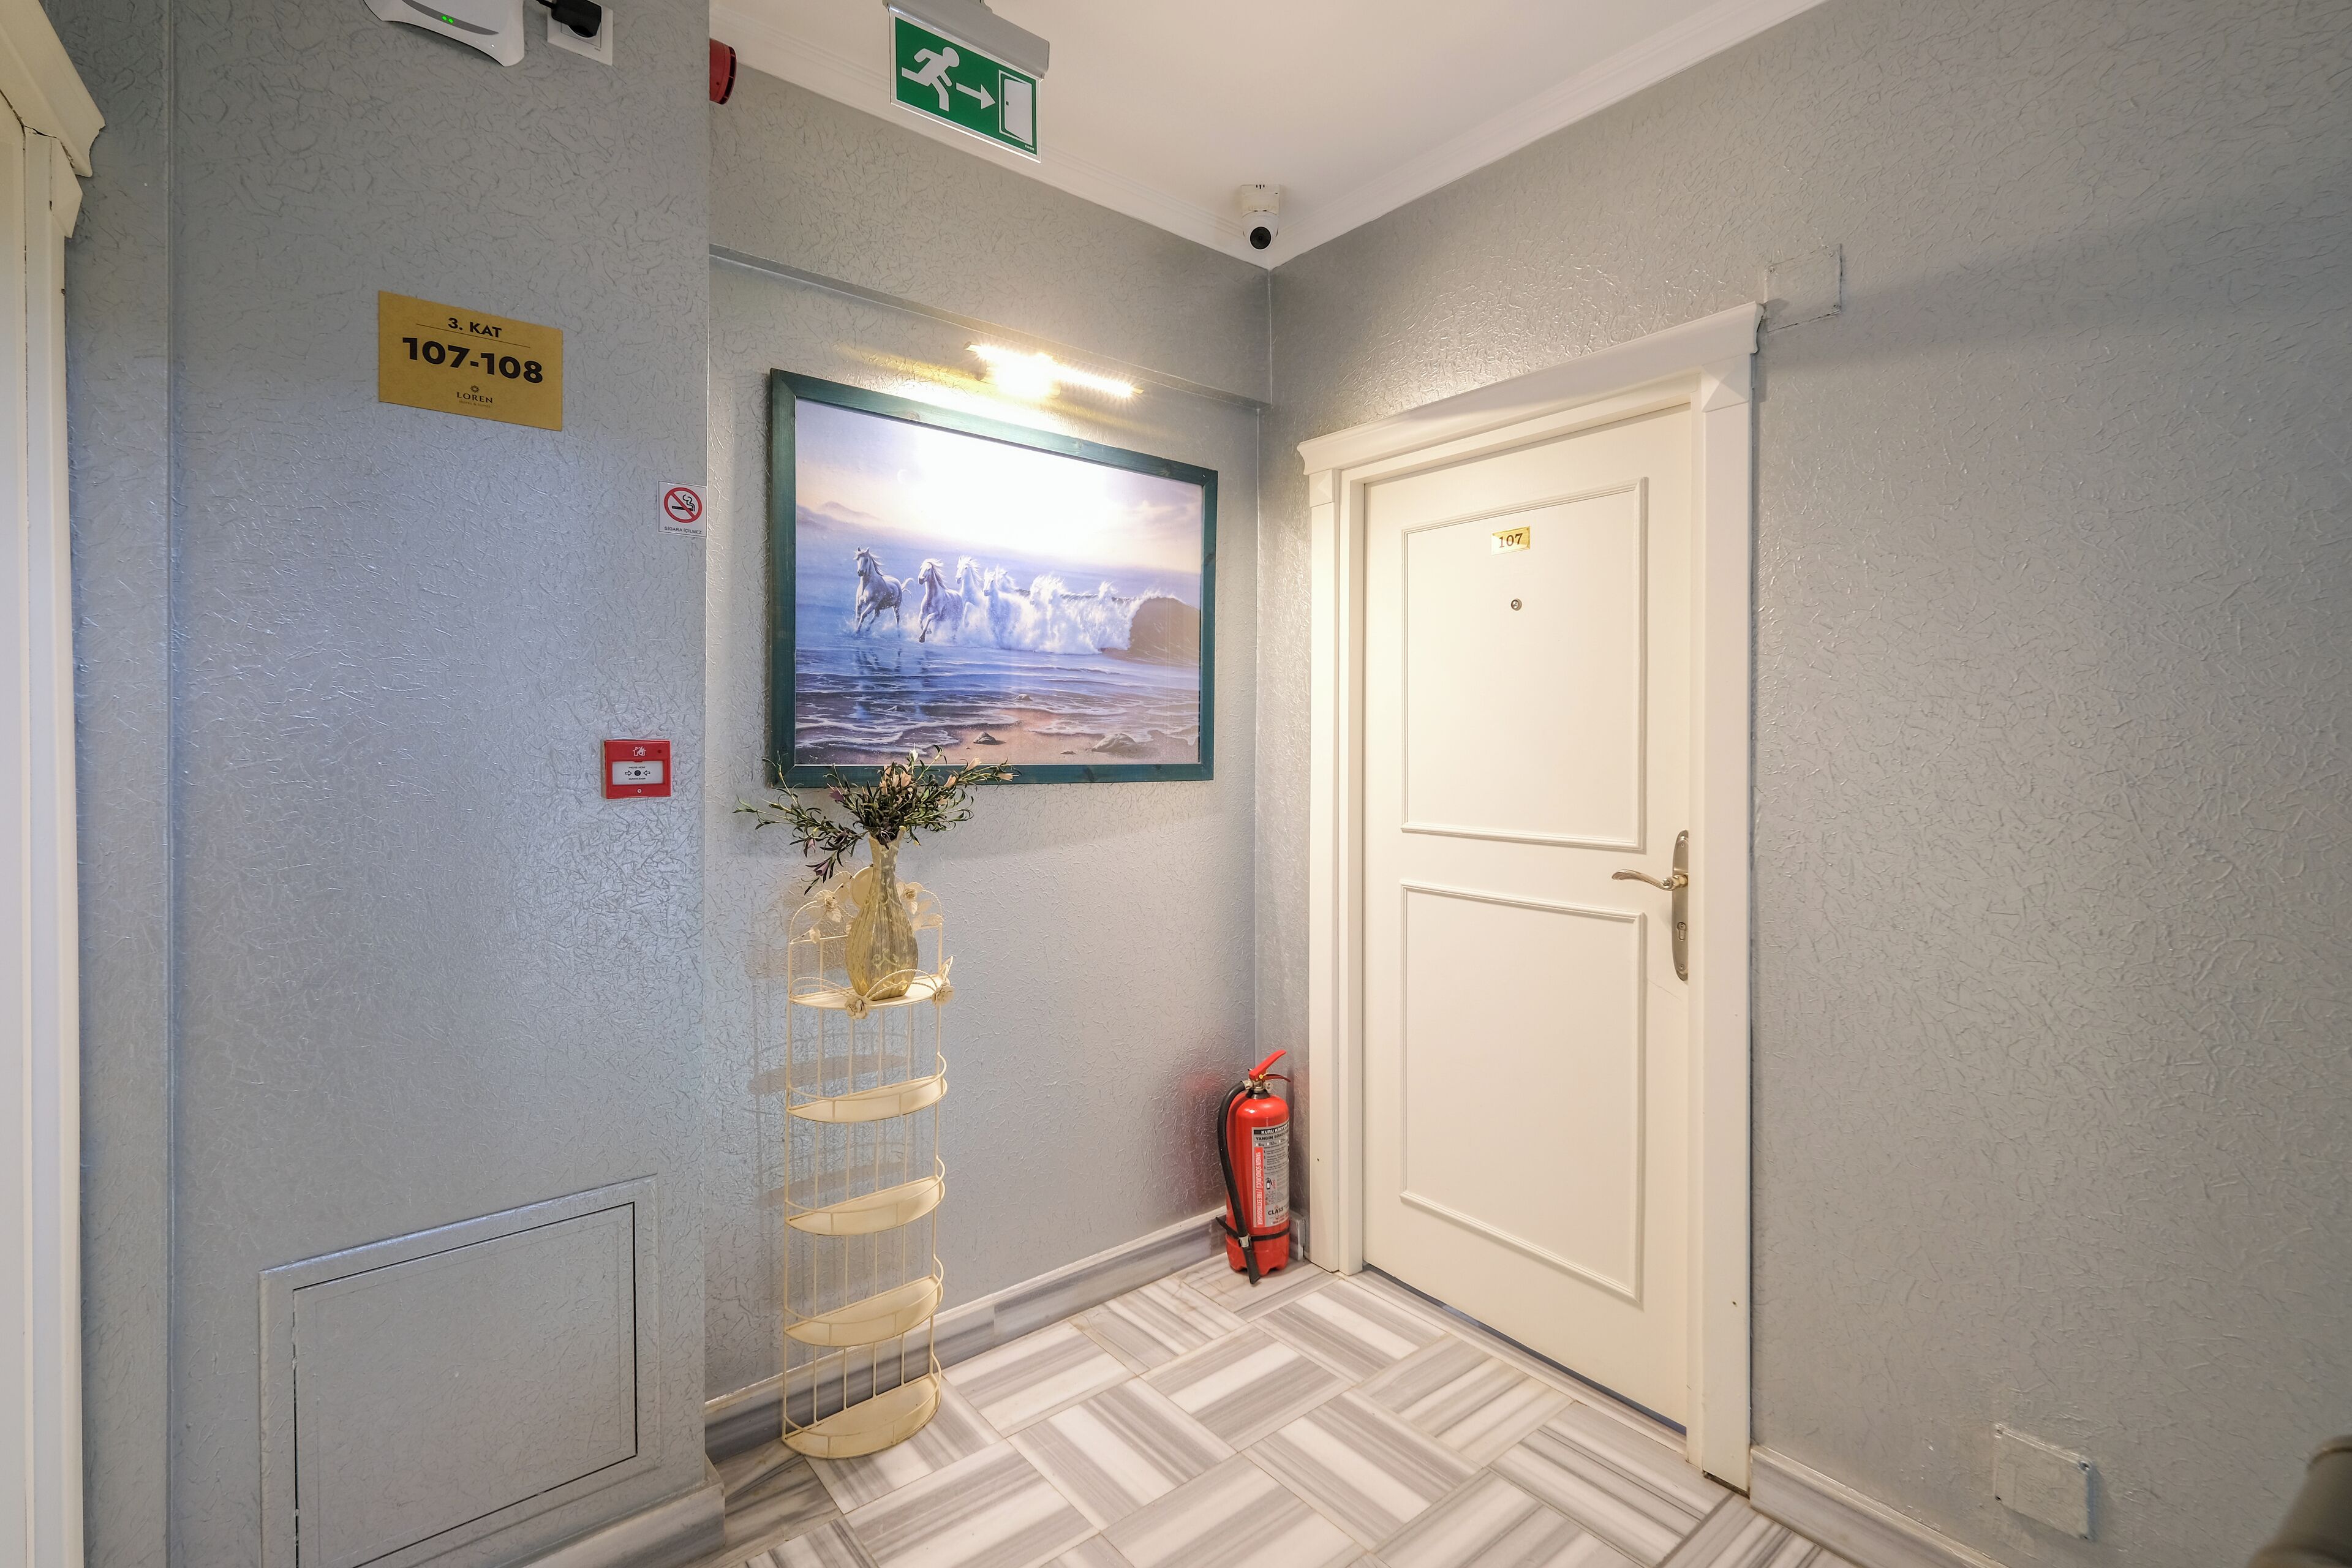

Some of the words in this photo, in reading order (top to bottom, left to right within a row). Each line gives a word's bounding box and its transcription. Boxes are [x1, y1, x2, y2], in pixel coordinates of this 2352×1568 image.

[448, 317, 462, 330] 3.
[470, 322, 502, 337] KAT
[402, 337, 543, 383] 107-108
[457, 391, 493, 404] LOREN
[1499, 533, 1523, 548] 107
[1268, 1207, 1284, 1215] CLASS
